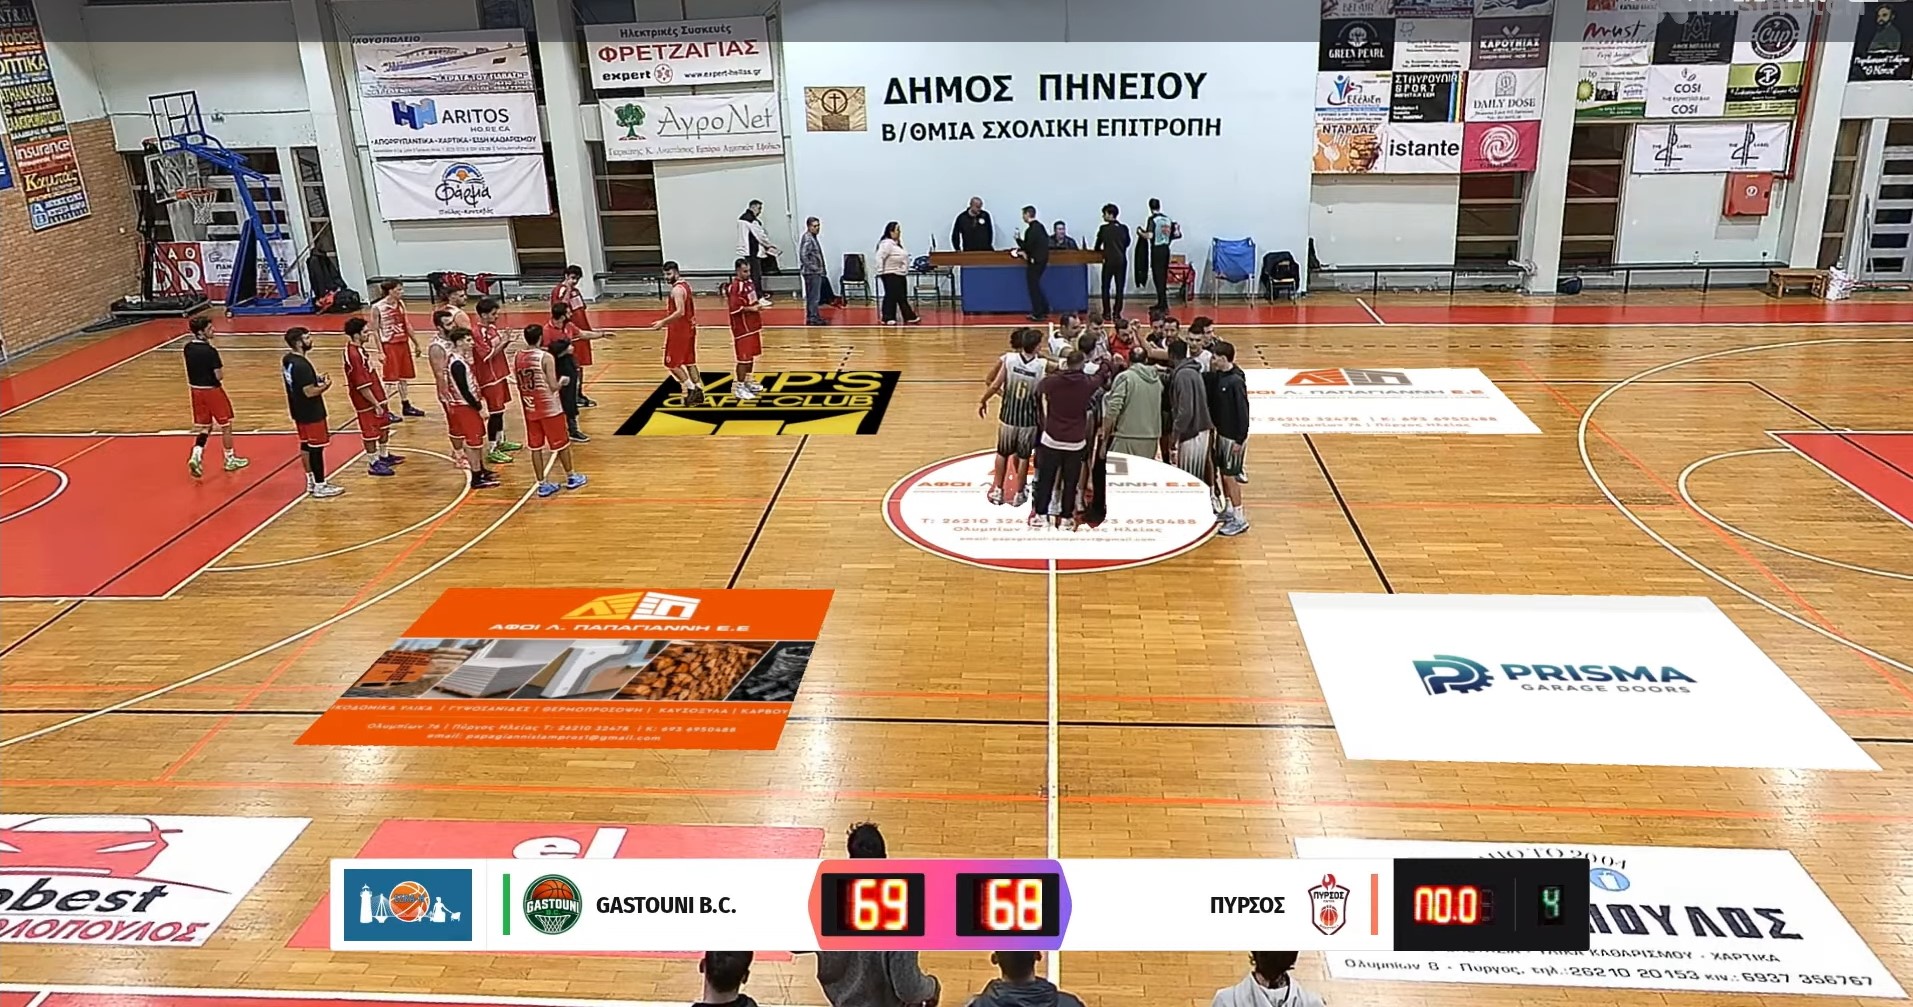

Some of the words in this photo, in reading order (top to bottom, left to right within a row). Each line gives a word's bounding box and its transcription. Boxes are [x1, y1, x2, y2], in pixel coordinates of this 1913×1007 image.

[620, 26, 679, 39] Ηλεκτρικές
[681, 24, 732, 36] Συσκευές
[1583, 19, 1646, 41] must
[598, 39, 760, 63] ΦΡΕΤΖΑΓΙΑΣ
[1328, 48, 1356, 59] GREEN
[1357, 47, 1385, 59] PEARL
[602, 70, 651, 82] expert
[684, 68, 762, 79] www.expert-hellas.gr
[883, 75, 1014, 104] ΔΗΜΟΣ
[1038, 72, 1208, 100] ΠΗΝΕΙΟΥ
[1395, 84, 1436, 93] SPORT
[1674, 83, 1701, 93] COSI
[1473, 98, 1505, 109] DAILY
[1508, 97, 1537, 108] DOSE
[1671, 104, 1698, 114] COSI
[881, 121, 976, 142] Β/ΘΜΙΑ
[981, 119, 1089, 139] ΣΧΟΛΙΚΗ
[1096, 117, 1222, 137] ΕΠΙΤΡΟΠΗ
[1323, 124, 1376, 134] ΝΤΑΡΔΑΣ
[13, 139, 70, 160] Insurance
[1389, 139, 1460, 157] istante
[488, 623, 541, 631] ΑΦΟΙ
[573, 624, 710, 632] ΠΑΠΑΓΙΑΝΝΗ
[1499, 663, 1699, 684] PRISMA
[1520, 683, 1609, 693] GARAGE
[1615, 684, 1692, 694] DOORS
[1590, 949, 1692, 961] ΚΑΘΑΡΙΣΜΟΥ
[1710, 952, 1781, 964] ΧΑΡΤΙΚΑ
[1637, 968, 1700, 980] 20153
[1798, 974, 1874, 986] 356767
